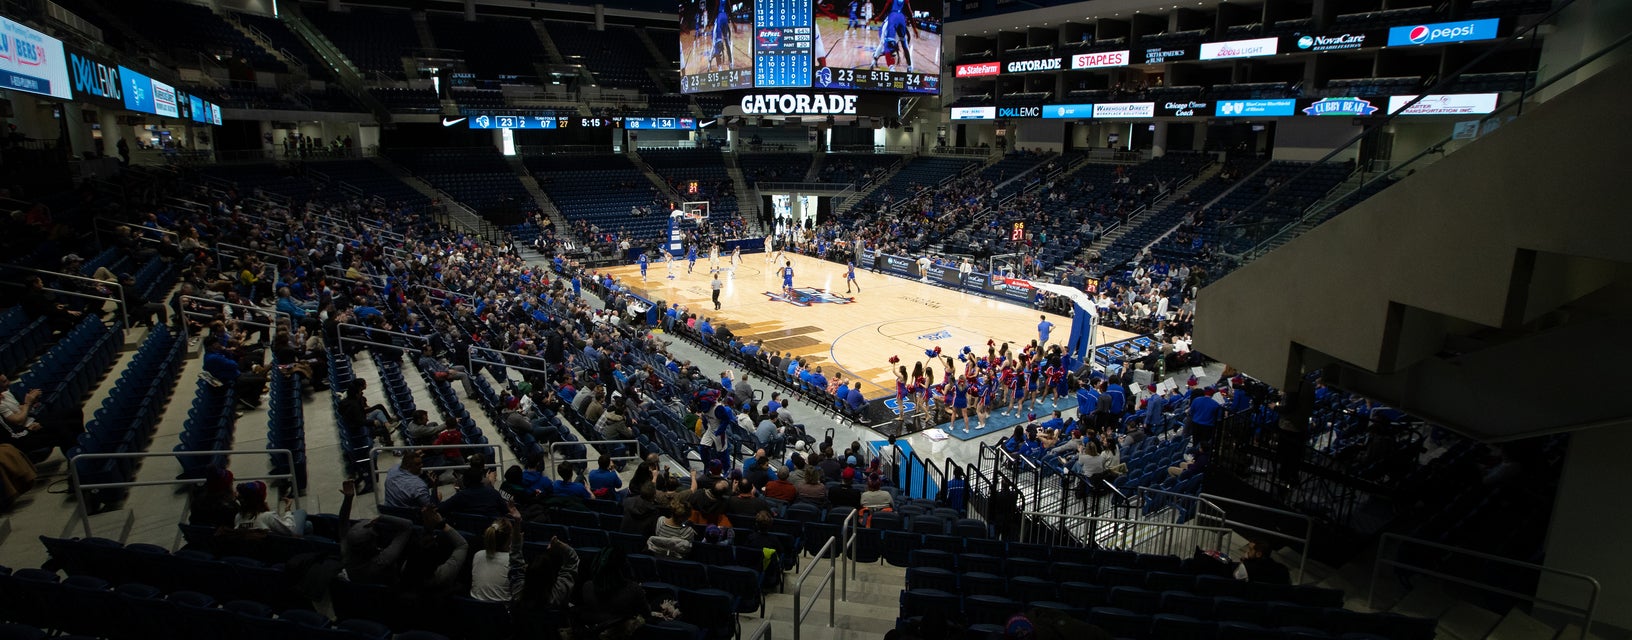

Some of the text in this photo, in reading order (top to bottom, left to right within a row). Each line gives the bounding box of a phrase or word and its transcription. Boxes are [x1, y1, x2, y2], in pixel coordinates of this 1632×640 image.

[1430, 24, 1474, 40] pepsi
[1314, 34, 1365, 46] NovaCare
[1008, 58, 1062, 72] GATORADE
[1078, 54, 1122, 66] STAPLES
[691, 76, 699, 86] 23
[708, 72, 719, 82] 5:15
[729, 71, 738, 82] 34
[838, 70, 854, 81] 23
[871, 71, 889, 81] 5:15
[906, 74, 920, 85] 34
[741, 94, 858, 114] GATORADE
[1316, 102, 1365, 112] CUBBY BEAR
[501, 118, 512, 126] 23
[1012, 229, 1022, 240] 27
